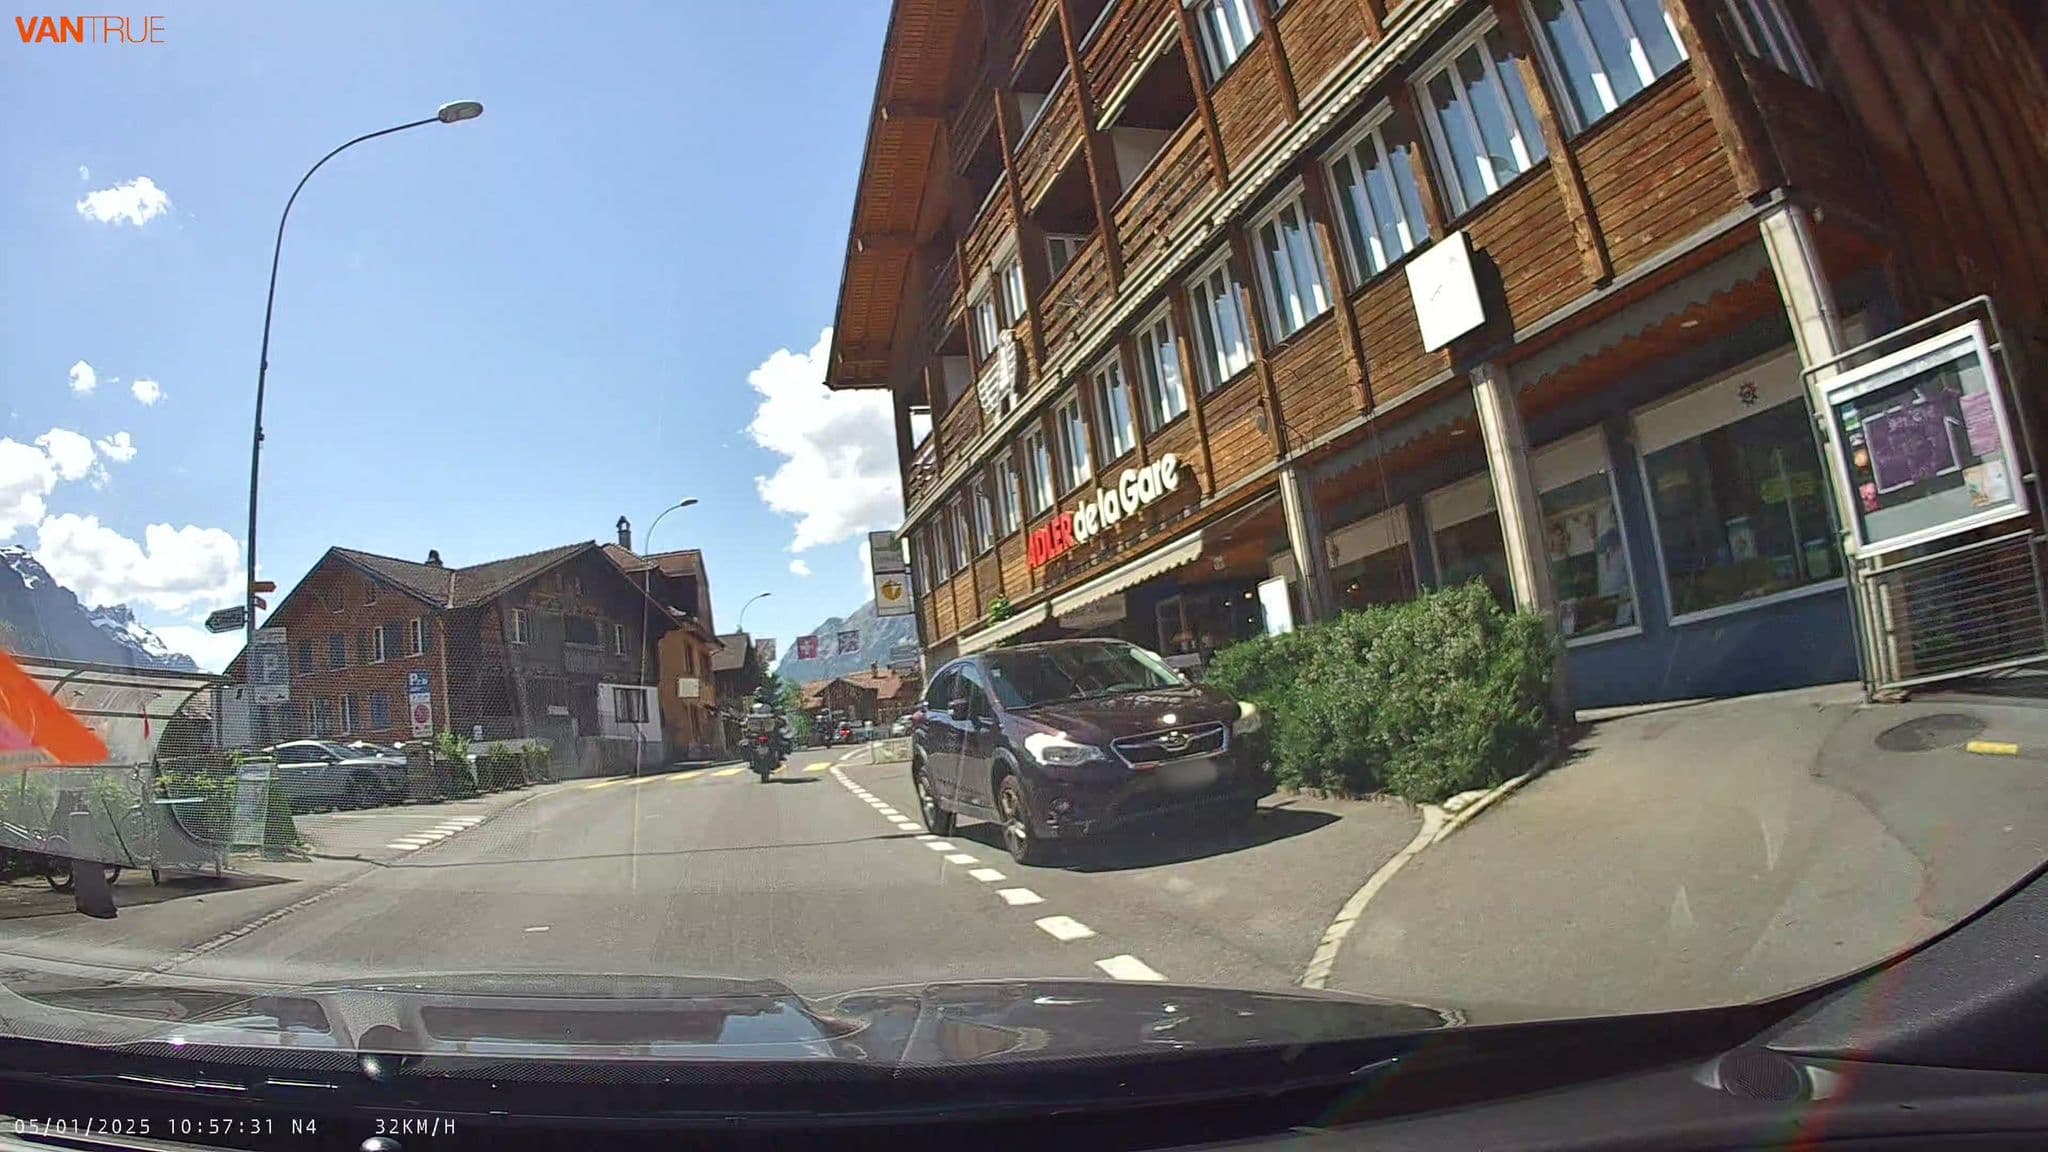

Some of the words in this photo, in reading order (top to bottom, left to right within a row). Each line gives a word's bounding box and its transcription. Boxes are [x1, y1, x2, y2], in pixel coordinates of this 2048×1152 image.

[1027, 511, 1077, 569] ADLER
[1073, 500, 1099, 544] de
[1096, 487, 1121, 527] la
[1119, 452, 1180, 515] Gare
